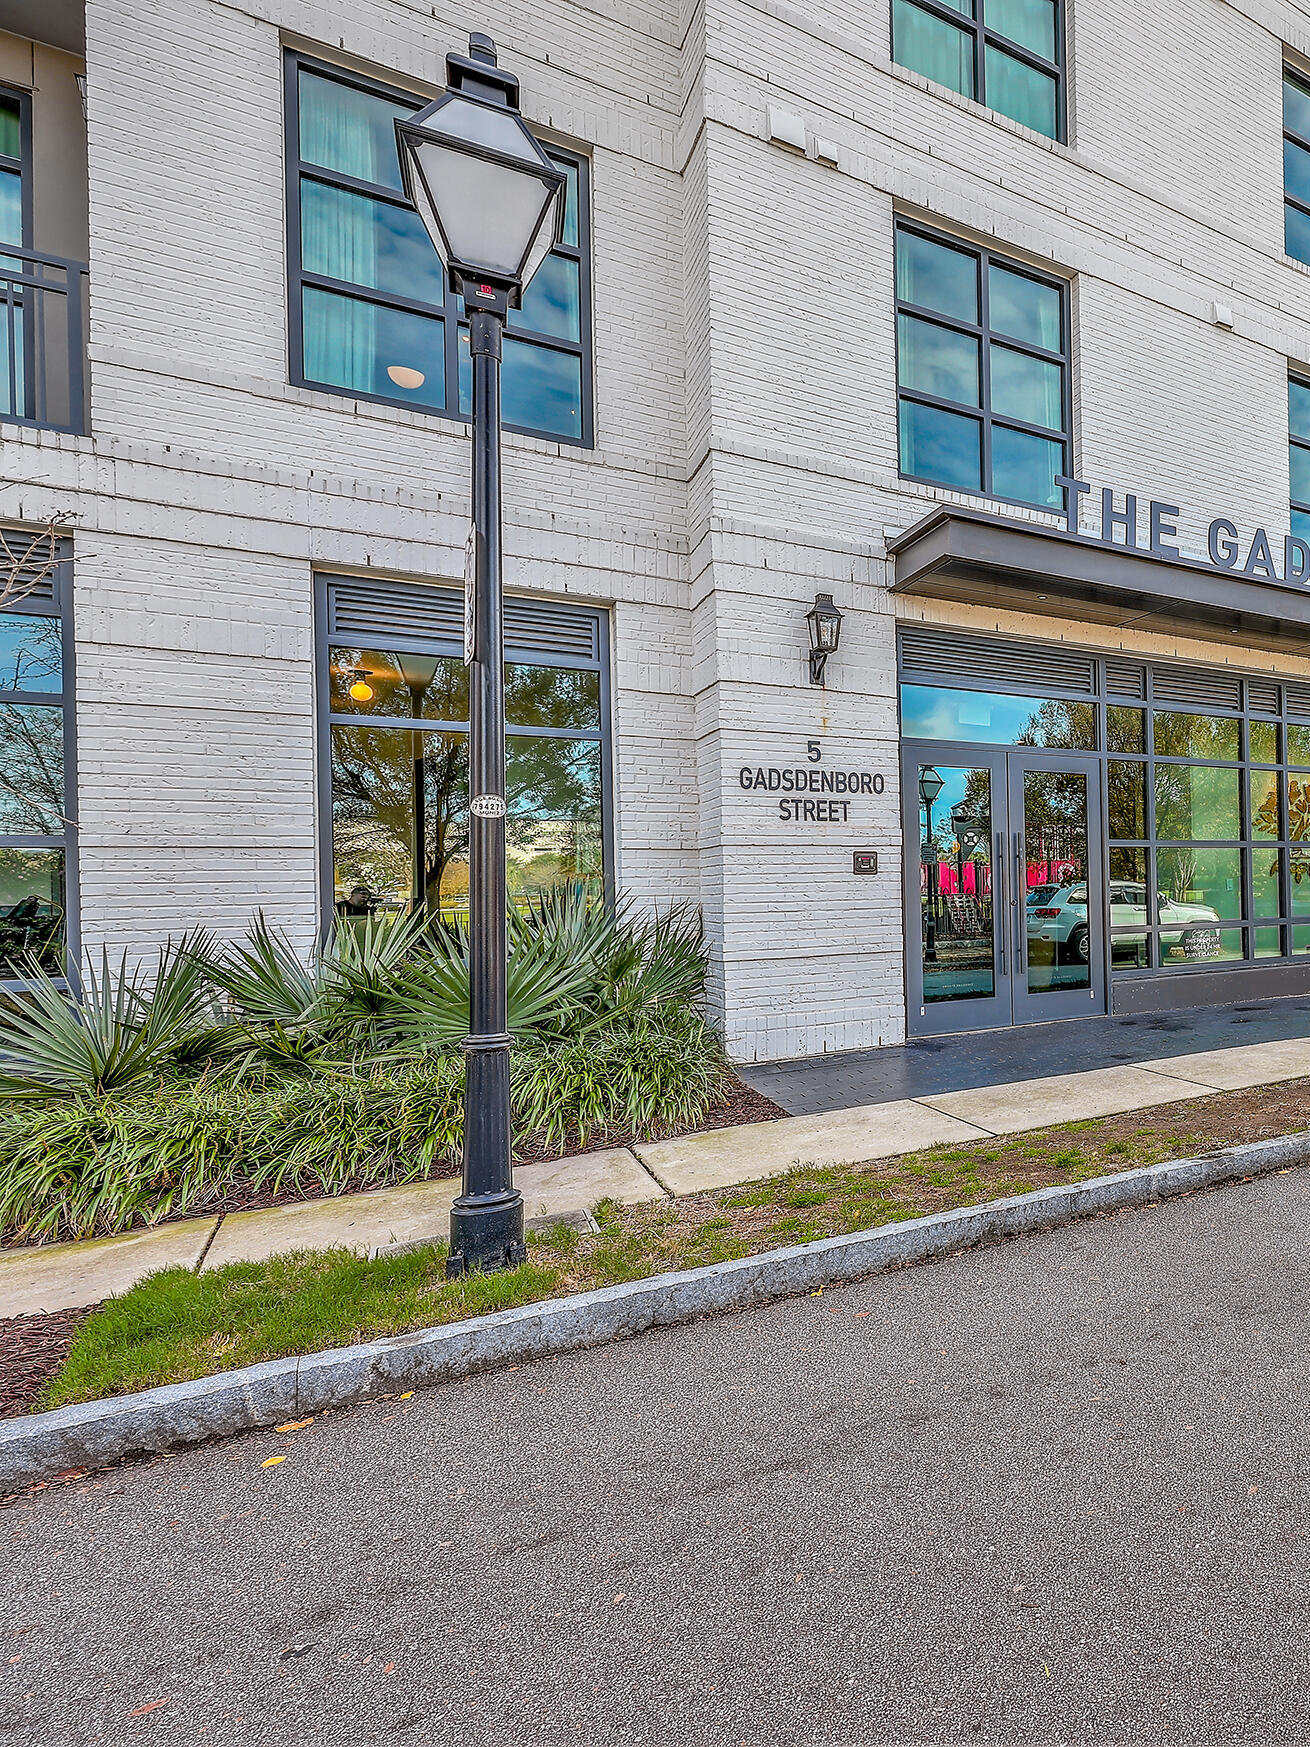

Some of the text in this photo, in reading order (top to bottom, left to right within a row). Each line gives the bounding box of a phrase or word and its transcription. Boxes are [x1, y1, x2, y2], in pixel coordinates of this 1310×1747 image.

[1054, 474, 1180, 558] THE
[806, 740, 822, 763] 5
[739, 766, 885, 795] GADSDENBORO
[473, 803, 505, 811] 794275
[778, 798, 851, 822] STREET
